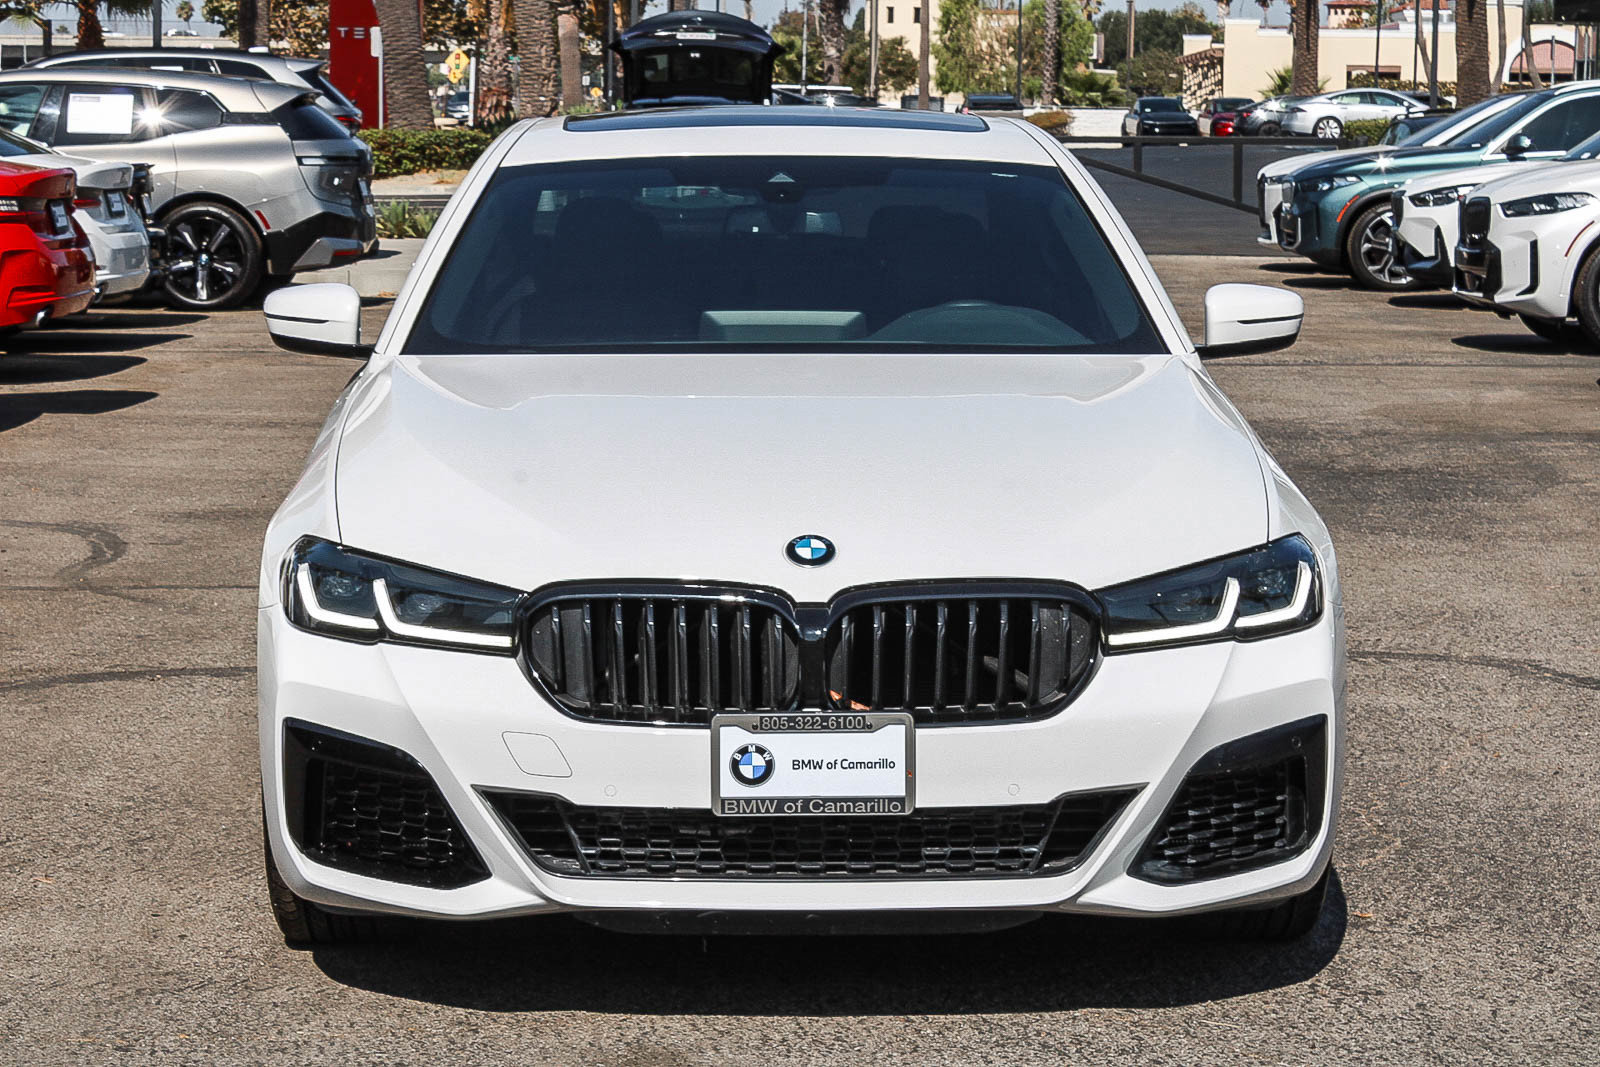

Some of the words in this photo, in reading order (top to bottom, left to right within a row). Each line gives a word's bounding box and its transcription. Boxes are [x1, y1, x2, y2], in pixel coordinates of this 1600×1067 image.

[762, 716, 864, 730] 805-322-6100
[733, 744, 773, 761] BMW
[792, 759, 824, 770] BMW
[826, 758, 839, 770] of
[840, 758, 896, 770] Camarillo
[724, 799, 778, 814] BMW
[784, 799, 804, 814] of
[809, 799, 902, 814] Camarillo
